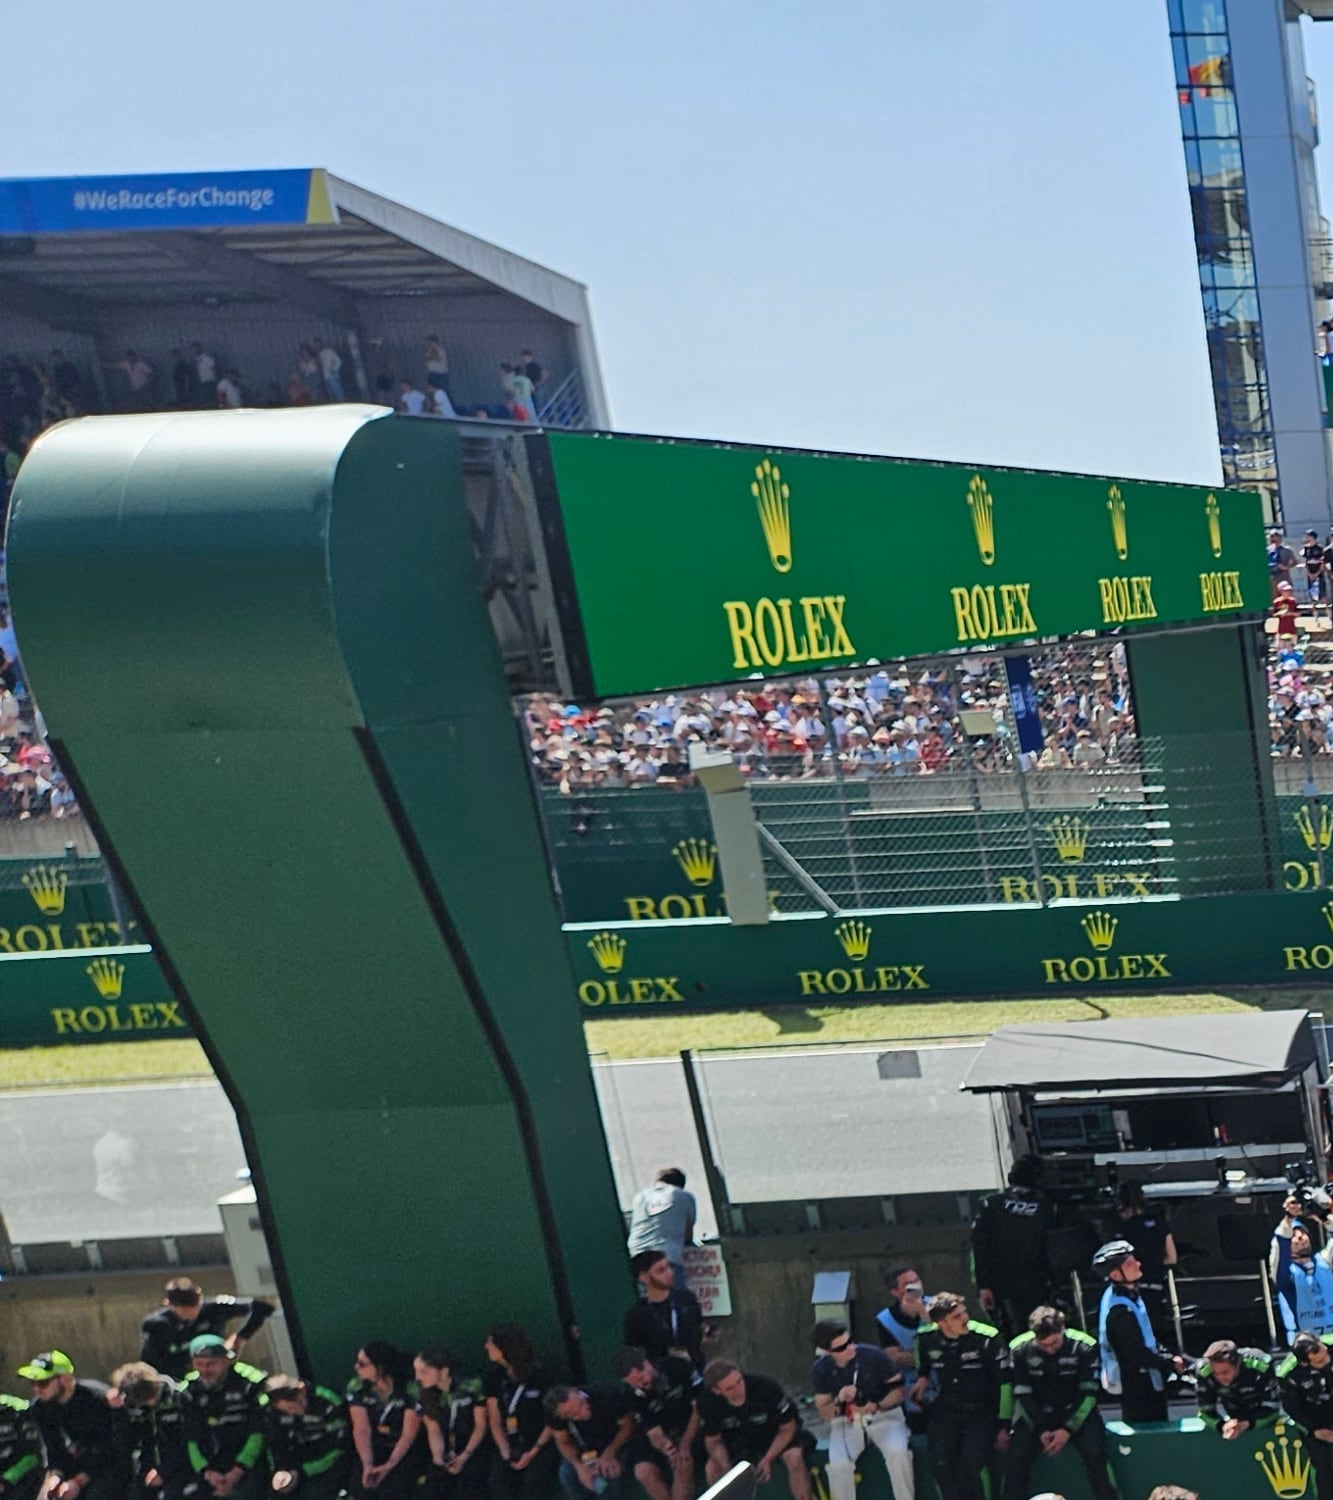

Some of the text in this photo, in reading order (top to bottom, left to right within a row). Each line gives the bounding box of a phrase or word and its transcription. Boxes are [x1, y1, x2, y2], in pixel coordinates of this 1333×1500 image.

[73, 185, 274, 212] #WeRaceForChange
[1098, 576, 1158, 623] ROLEX
[1199, 571, 1244, 612] ROLEX
[951, 583, 1038, 640] ROLEX
[723, 595, 856, 669] ROLEX
[799, 965, 929, 995] ROLEX
[1042, 954, 1172, 983] ROLEX
[578, 977, 684, 1007] OLEX
[51, 1001, 187, 1035] ROLEX
